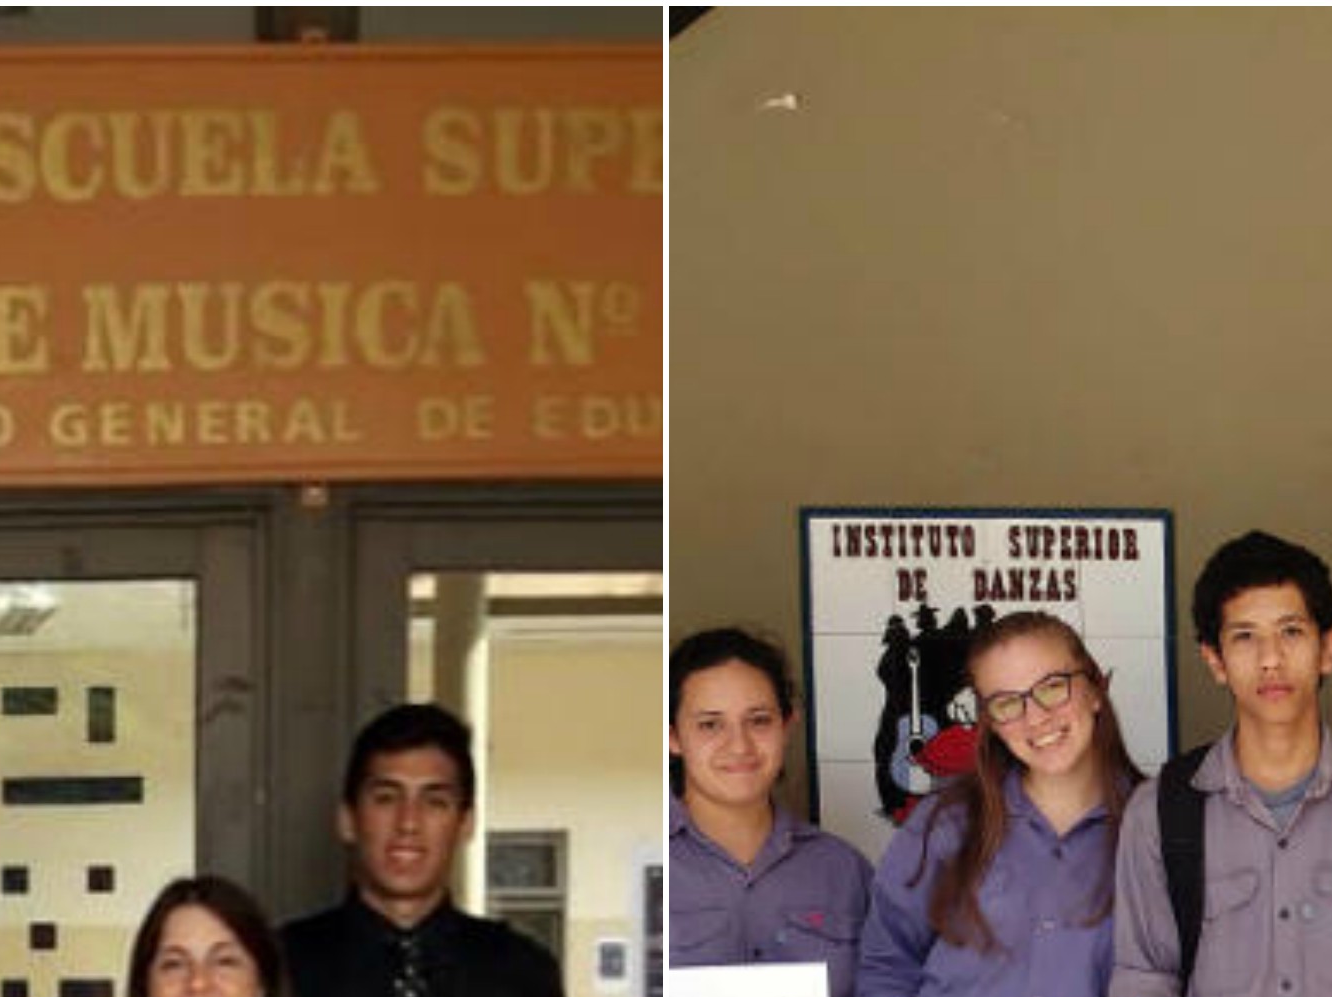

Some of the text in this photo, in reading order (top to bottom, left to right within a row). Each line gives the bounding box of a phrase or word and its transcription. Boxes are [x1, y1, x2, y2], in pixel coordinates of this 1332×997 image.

[82, 282, 485, 374] MUSICA
[50, 399, 358, 448] GENERAL
[419, 396, 494, 441] DE
[833, 525, 1139, 560] INSTITUTO SUPERIOR
[897, 569, 1077, 601] DE DANZAS
